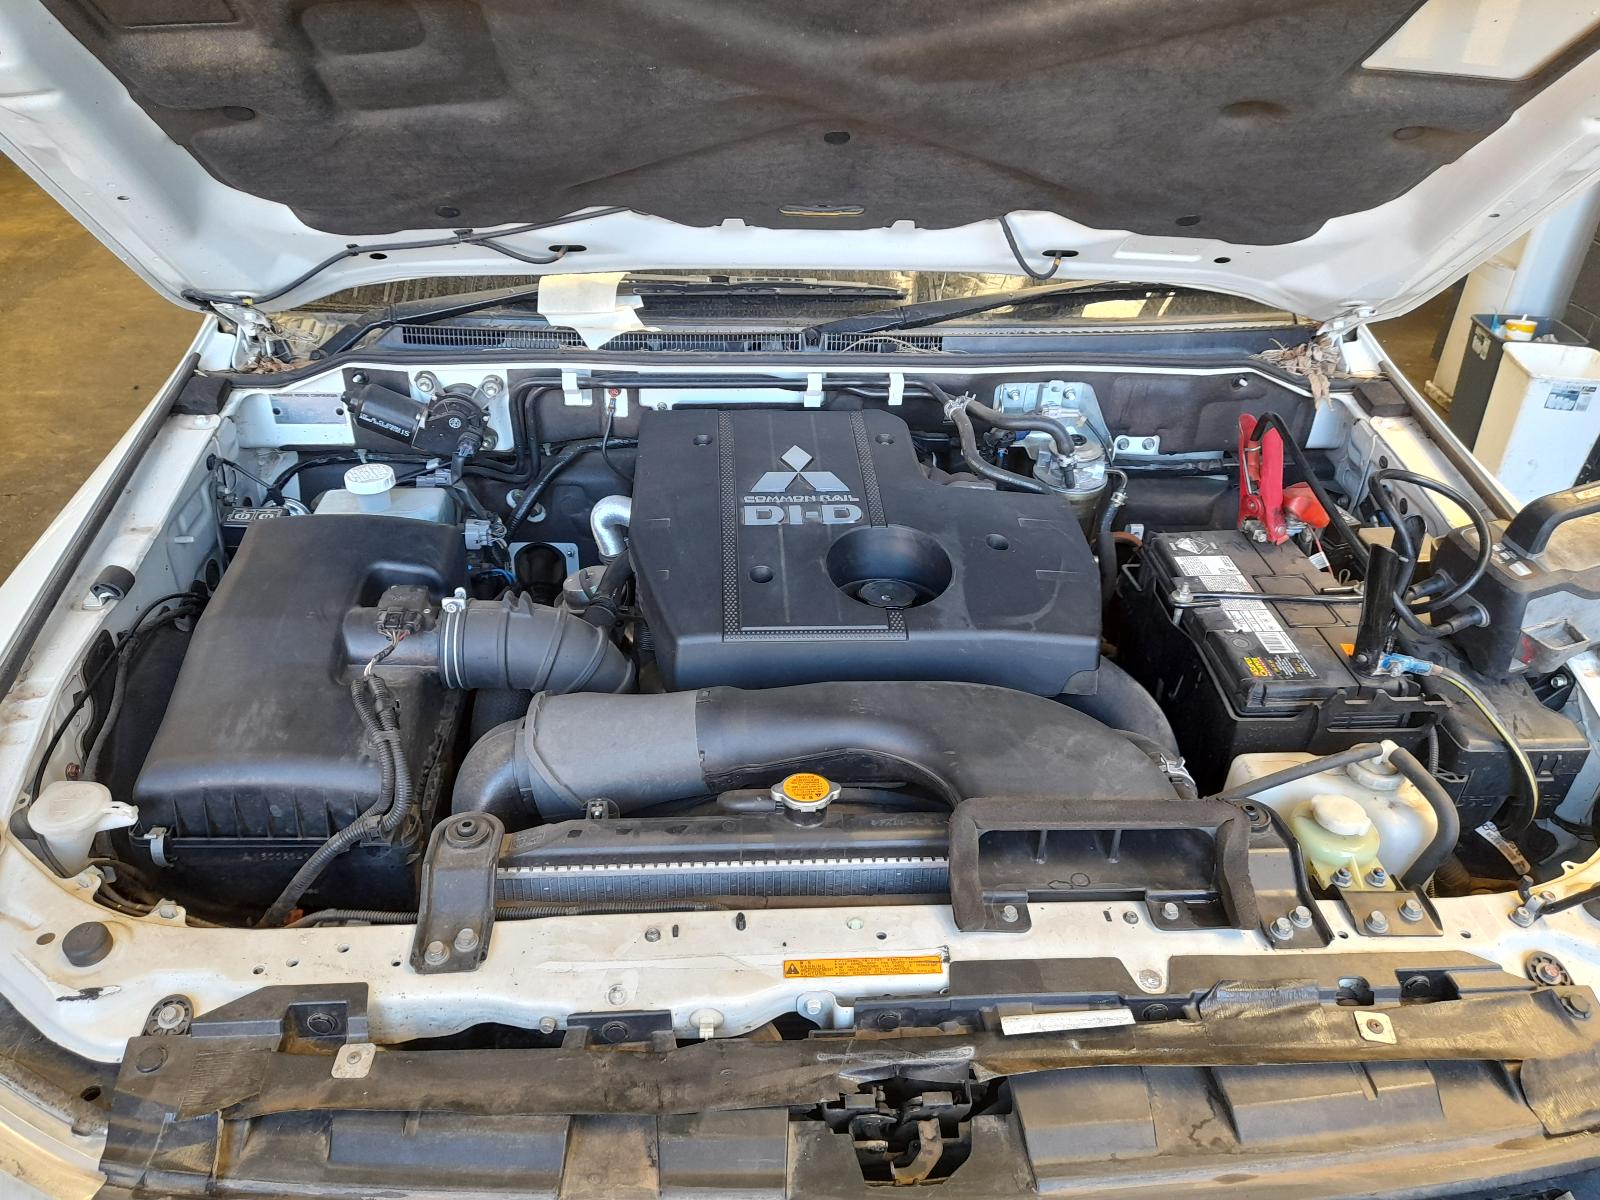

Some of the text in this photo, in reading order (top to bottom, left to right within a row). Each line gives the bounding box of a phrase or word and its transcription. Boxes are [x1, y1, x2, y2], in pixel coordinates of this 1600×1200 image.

[743, 494, 860, 503] COMMON RAIL
[743, 504, 863, 526] DI-D
